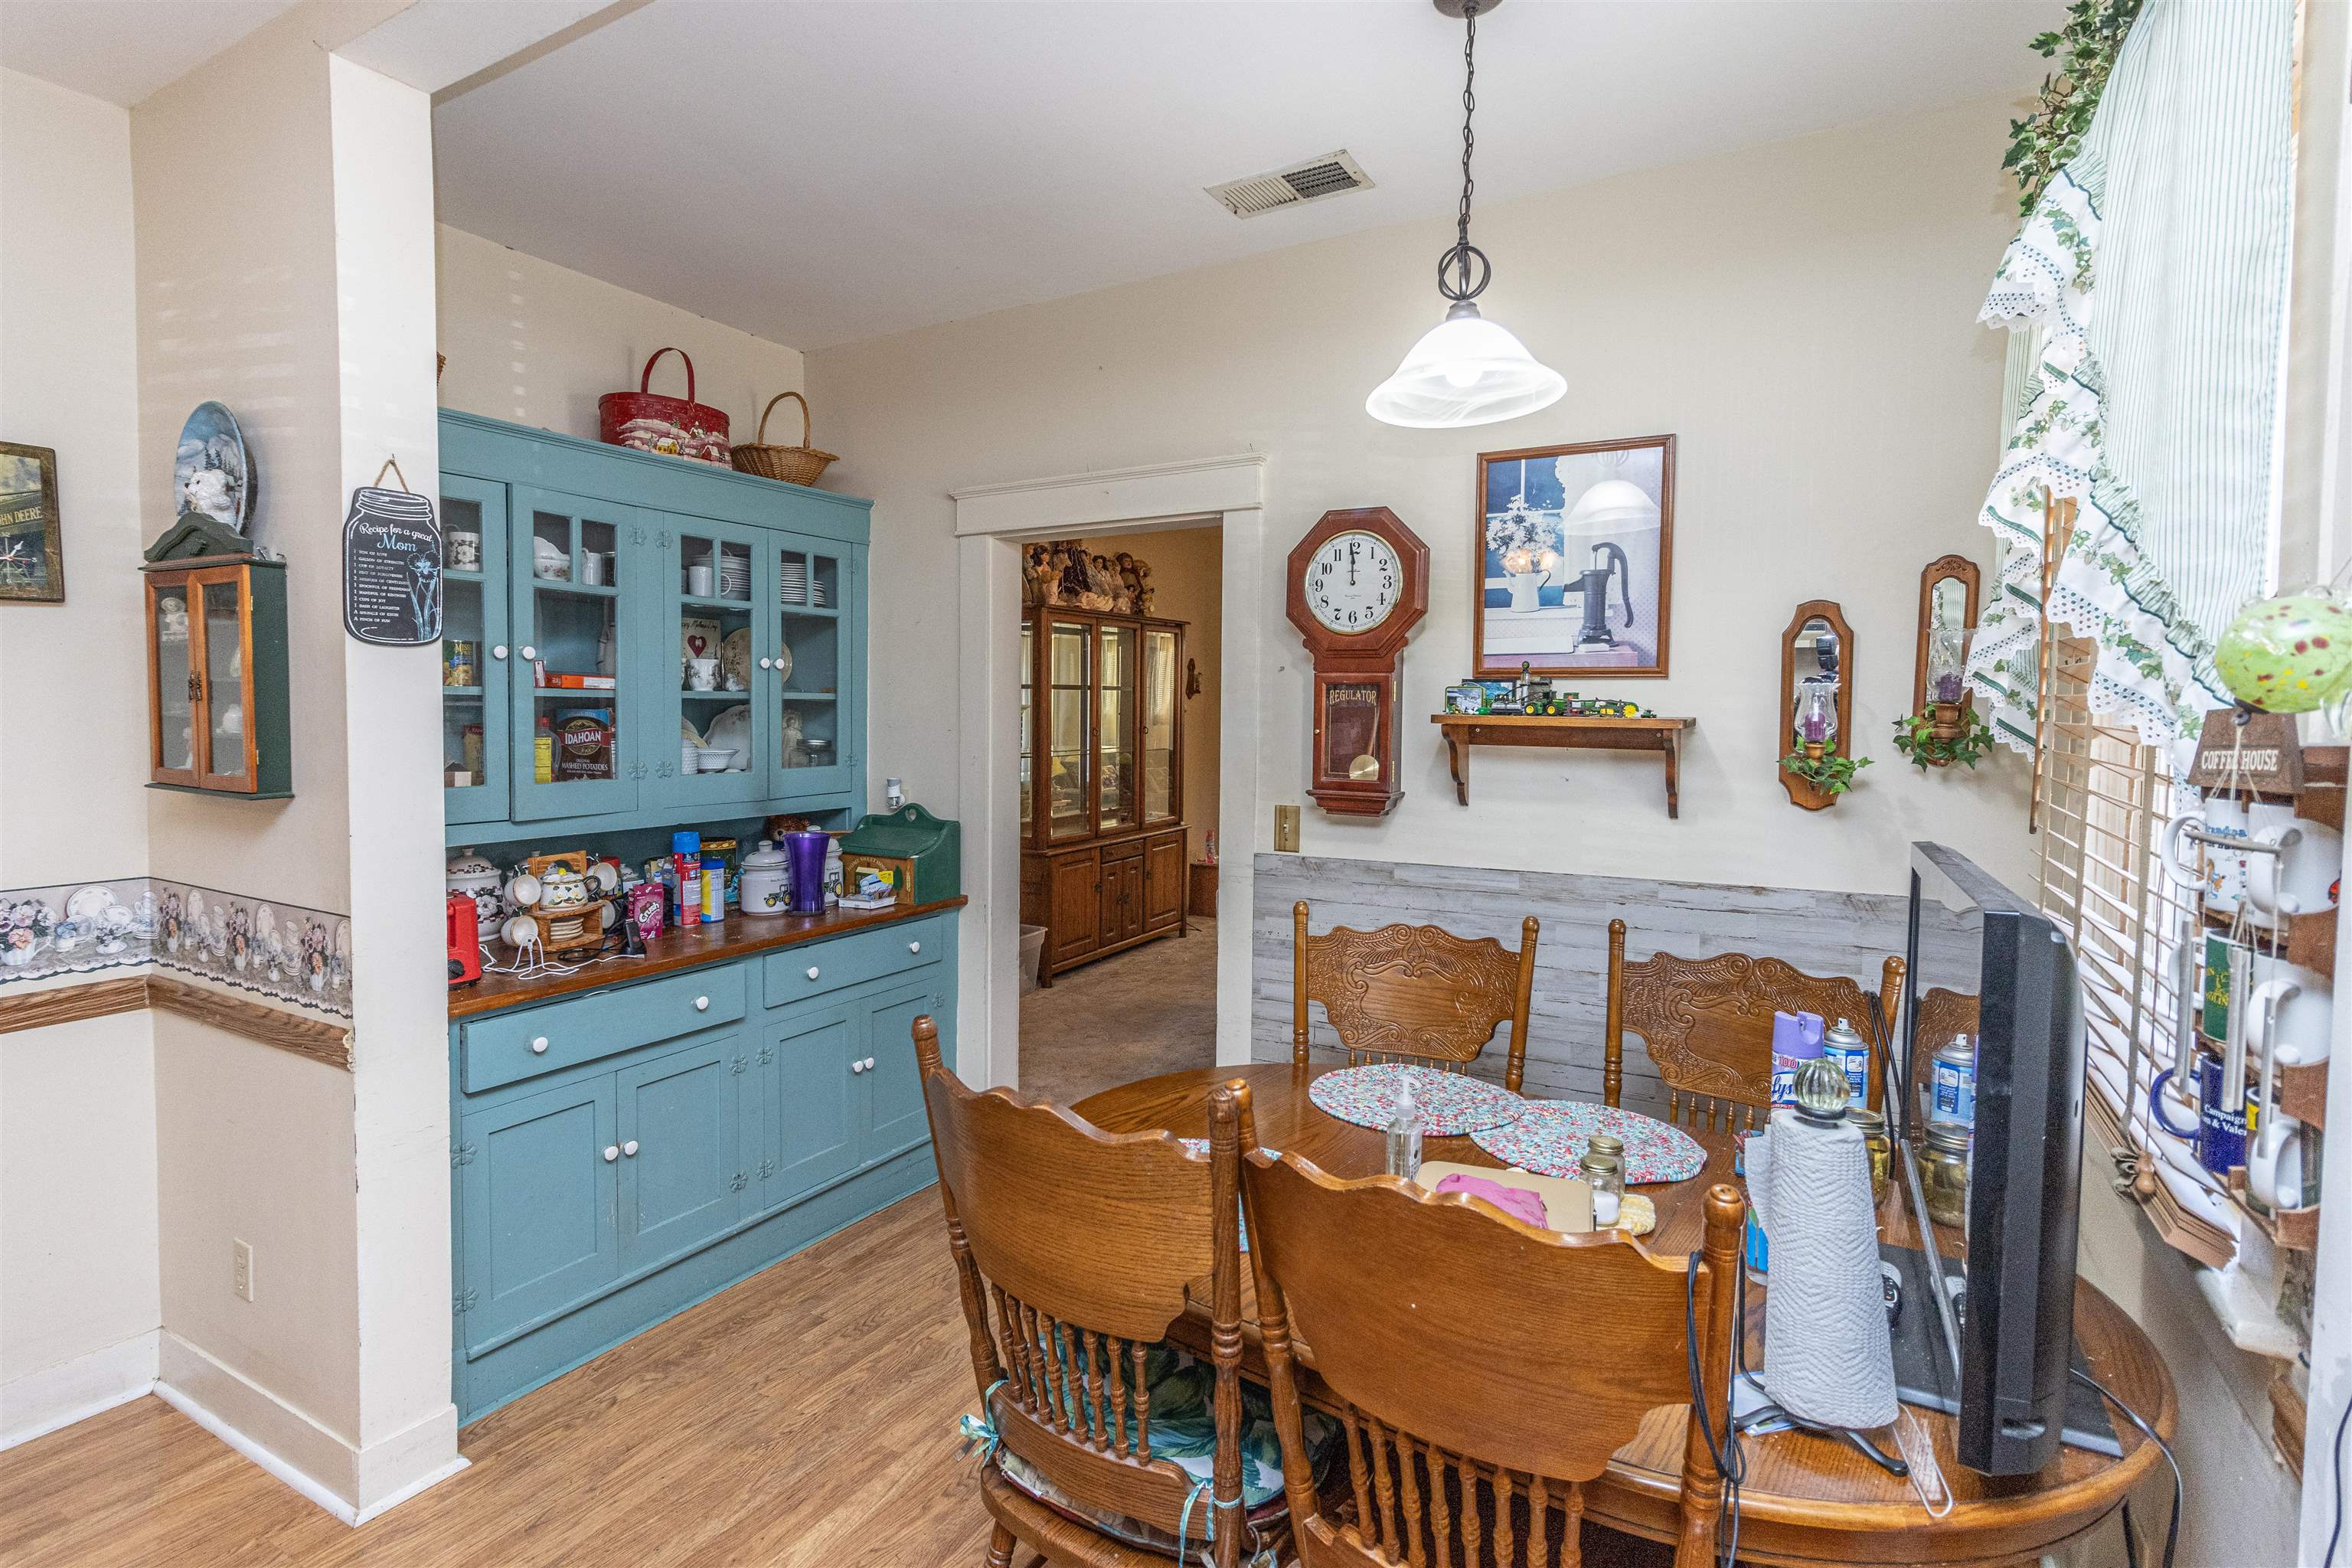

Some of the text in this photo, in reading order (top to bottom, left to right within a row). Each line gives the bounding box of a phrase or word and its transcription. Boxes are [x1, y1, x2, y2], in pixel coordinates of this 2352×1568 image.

[15, 506, 43, 523] DEERE
[359, 522, 389, 536] Recipe
[390, 523, 403, 536] for
[412, 531, 433, 542] great
[377, 533, 417, 552] Mom
[1334, 548, 1342, 562] 11
[1370, 546, 1375, 560] 1
[1321, 562, 1333, 575] 10
[1379, 558, 1388, 572] 2
[1315, 578, 1324, 593] 9
[1382, 574, 1393, 590] 3
[1320, 595, 1329, 609] 8
[1376, 592, 1387, 606] 4
[1334, 608, 1342, 621] 7
[1348, 610, 1357, 624] 6
[1364, 606, 1374, 619] 5
[1329, 689, 1377, 706] REGULATOR
[564, 730, 601, 745] IDAHOAN
[561, 761, 608, 771] MASHED POTATOES
[2201, 749, 2278, 772] COFFEE HOUSE
[639, 902, 660, 923] Crush
[2212, 1119, 2220, 1129] &
